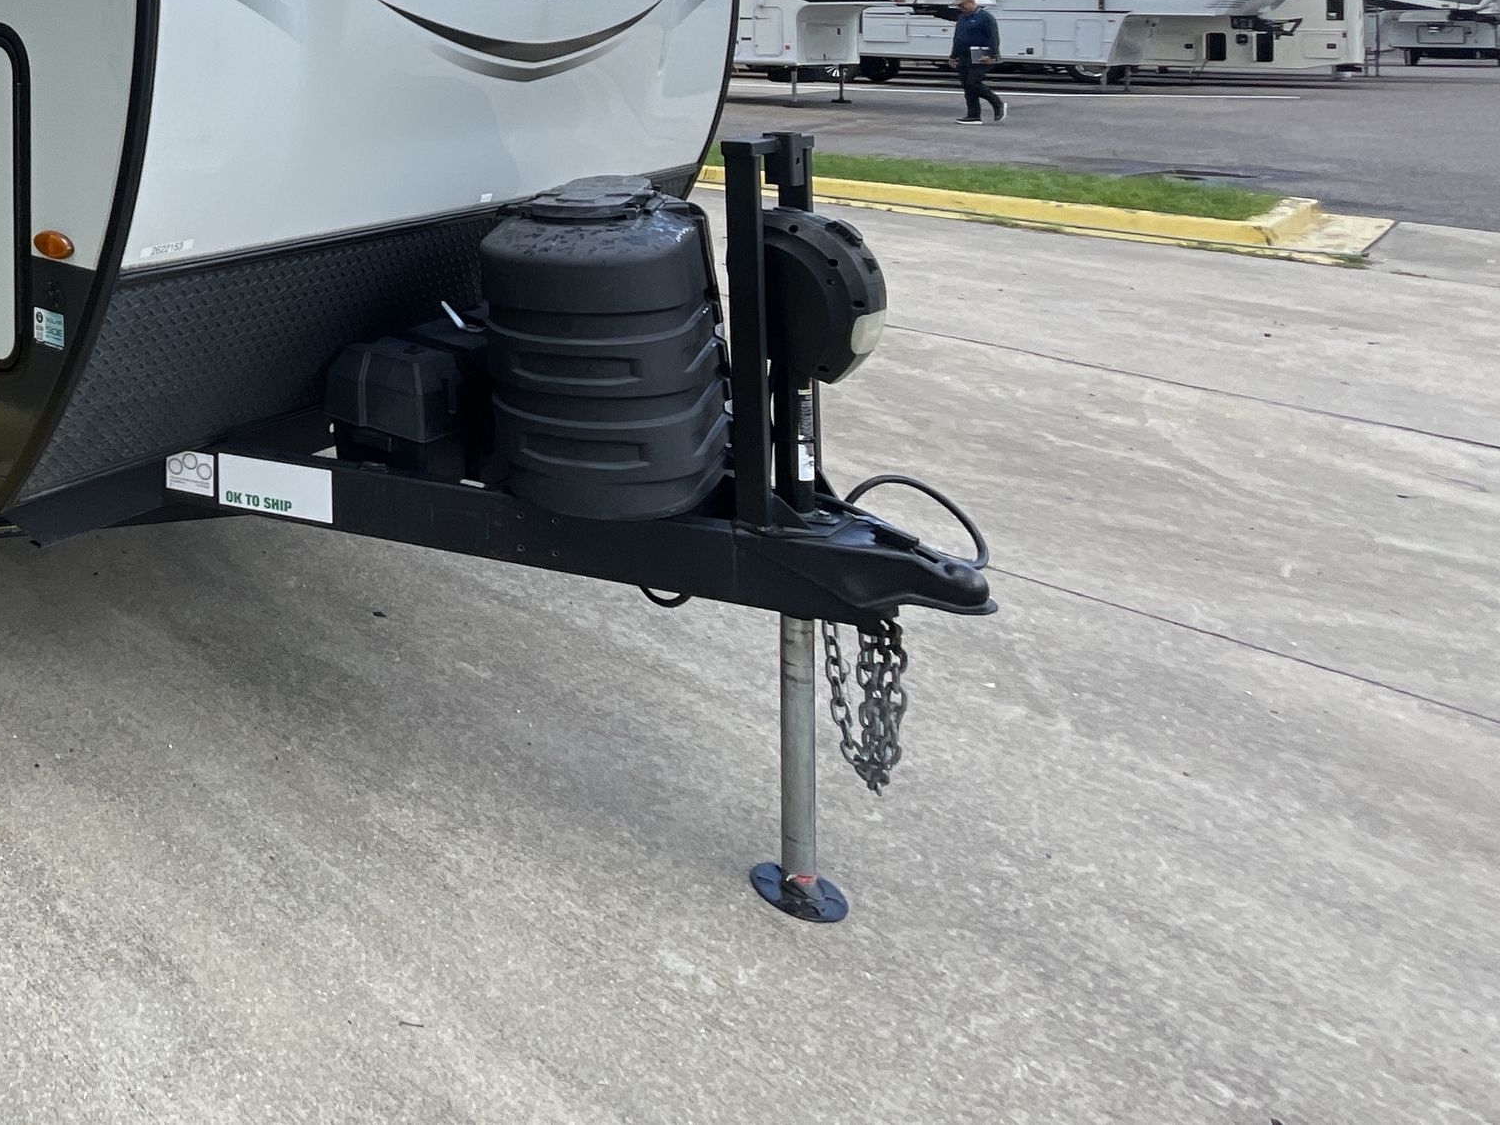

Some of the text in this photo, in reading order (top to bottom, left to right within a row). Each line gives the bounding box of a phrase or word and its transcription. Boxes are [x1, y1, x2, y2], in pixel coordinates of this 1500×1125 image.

[225, 490, 292, 512] OK TO SHIP
